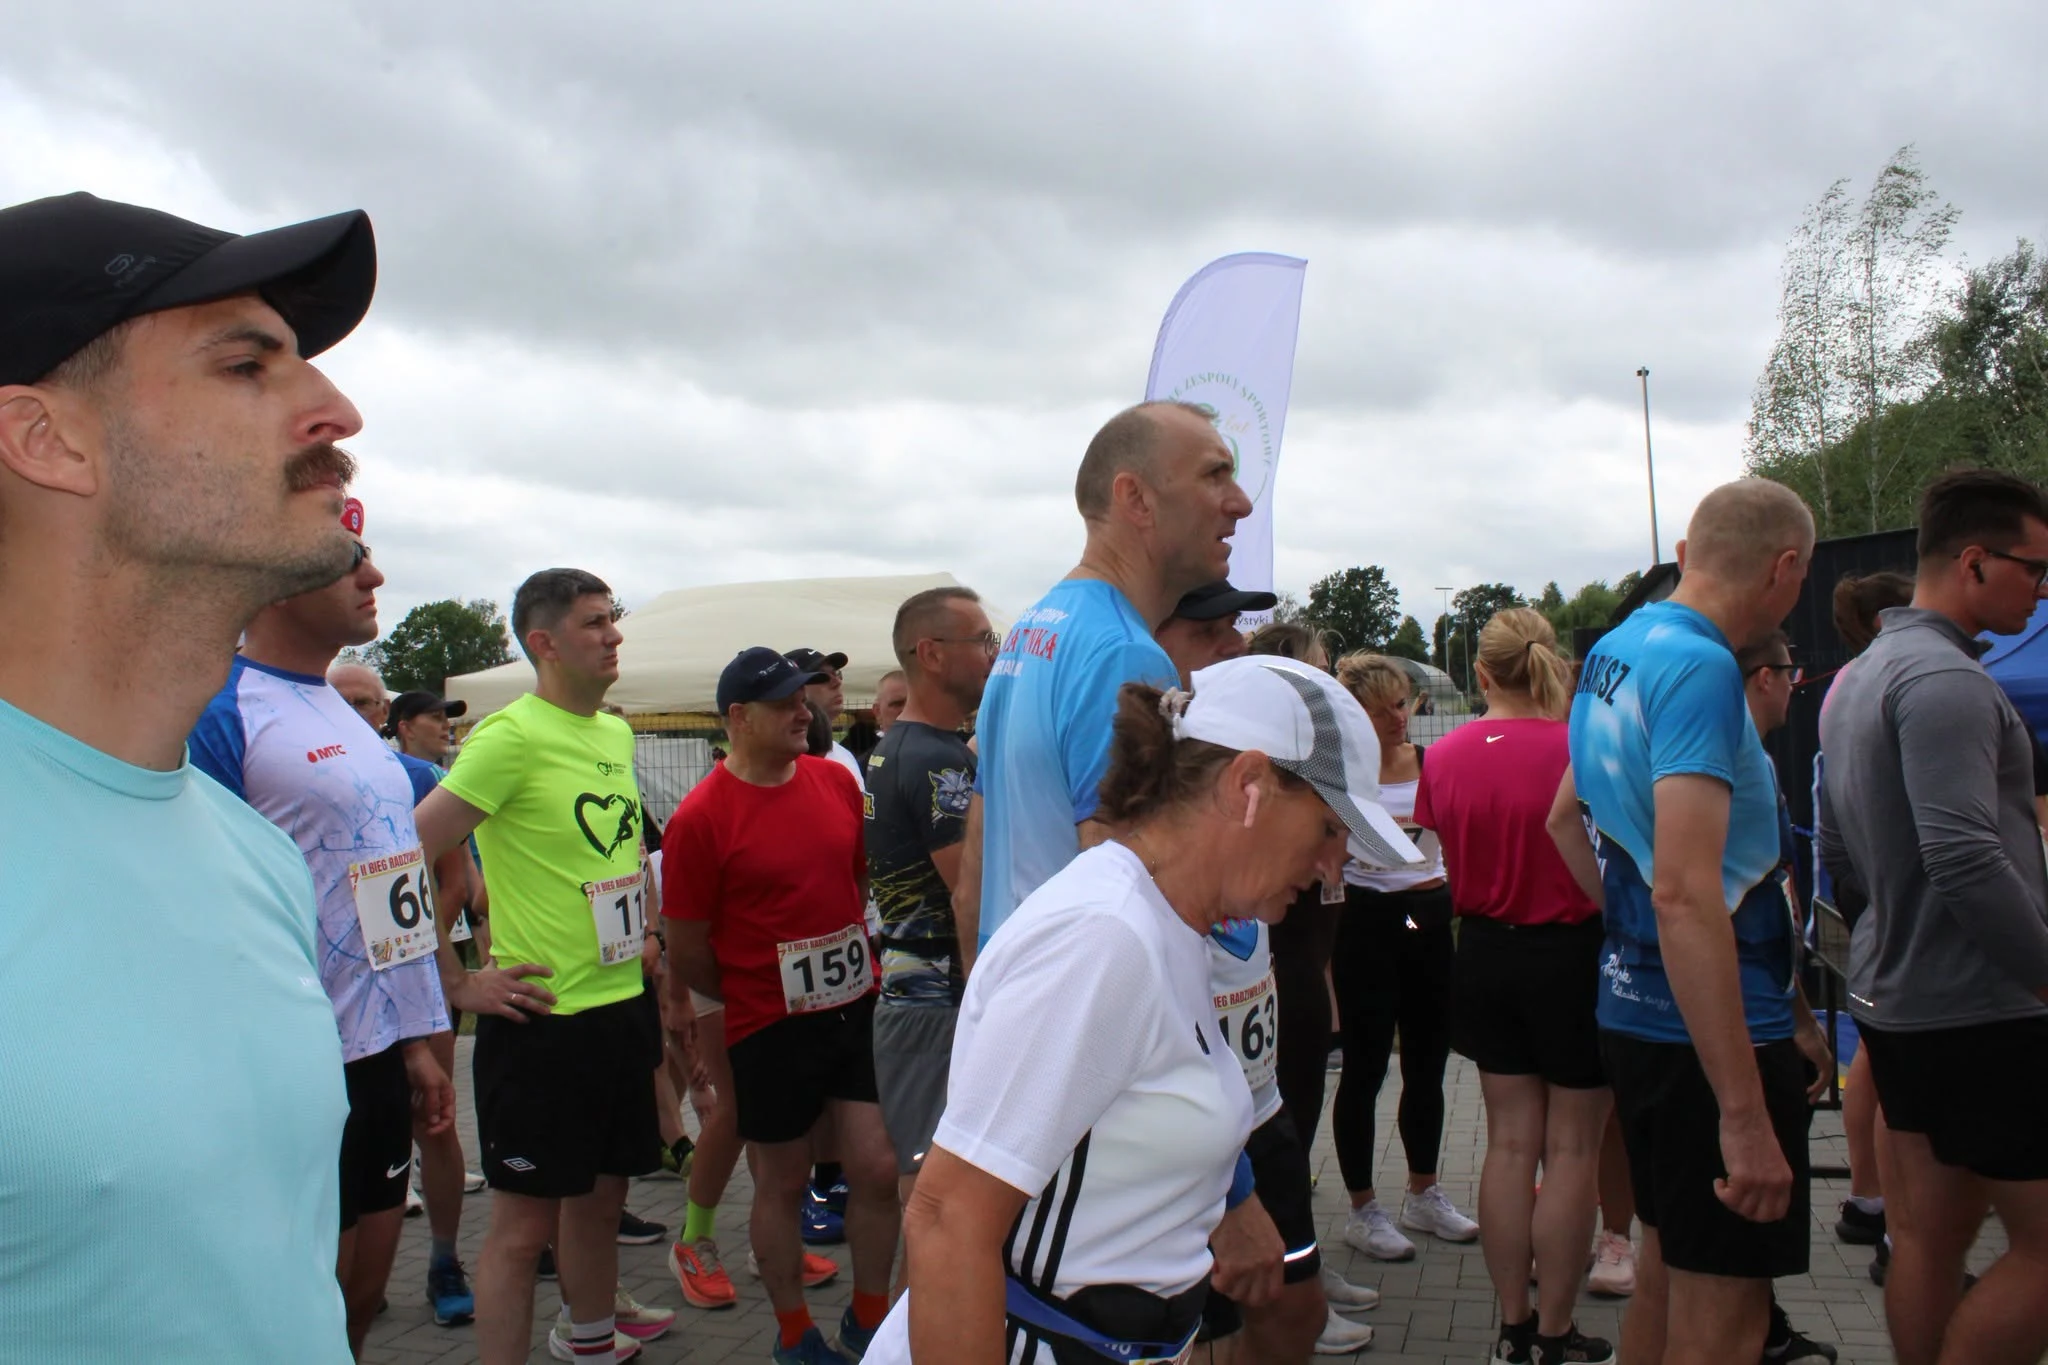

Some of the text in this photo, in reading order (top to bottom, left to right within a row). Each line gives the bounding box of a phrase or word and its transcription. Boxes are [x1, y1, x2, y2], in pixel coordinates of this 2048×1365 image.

[1237, 615, 1269, 626] ystyki
[316, 744, 346, 760] MTC
[368, 859, 388, 874] BIEG
[389, 868, 434, 930] 66
[792, 939, 865, 994] 159
[1213, 993, 1228, 1009] IEG
